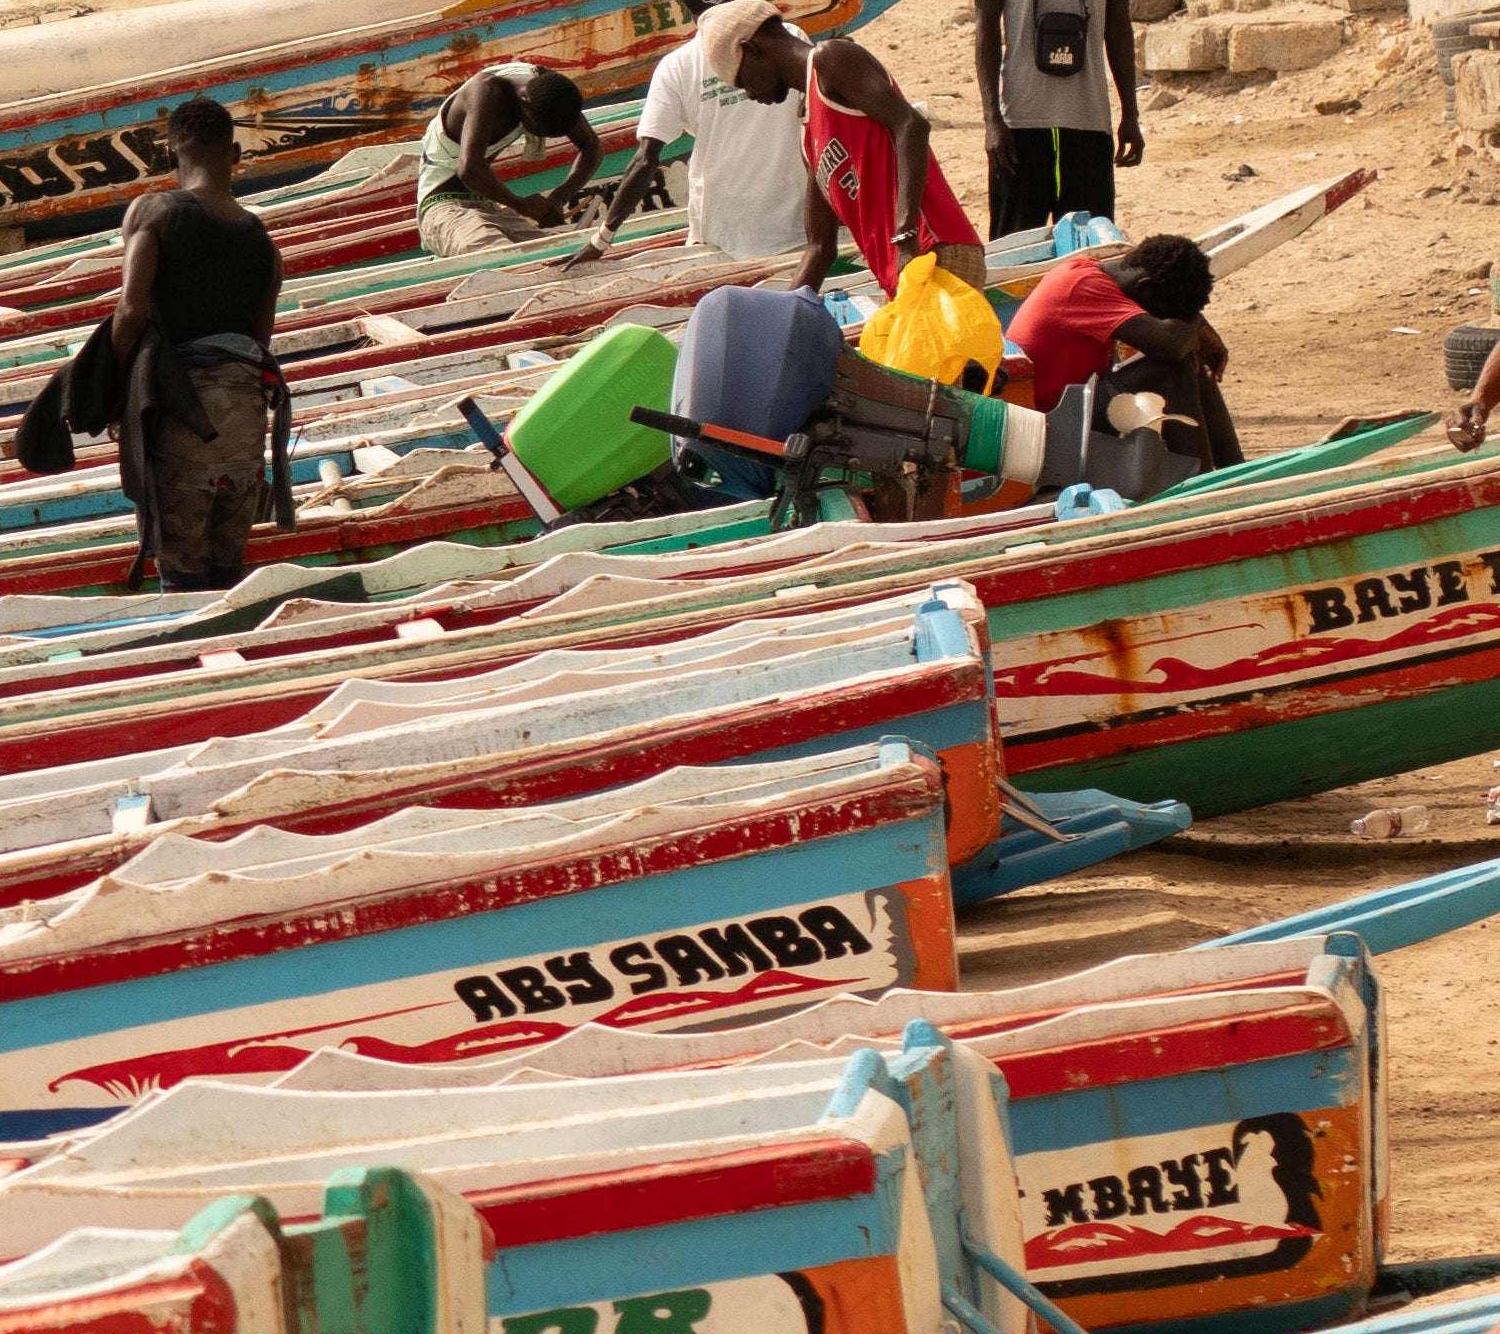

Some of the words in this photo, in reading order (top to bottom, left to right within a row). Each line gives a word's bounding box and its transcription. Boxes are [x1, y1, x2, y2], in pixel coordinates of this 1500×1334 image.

[1303, 561, 1469, 634] BAYE
[455, 952, 613, 1022] ABY
[607, 905, 873, 997] SAMBA
[1043, 1148, 1240, 1227] MBAYE
